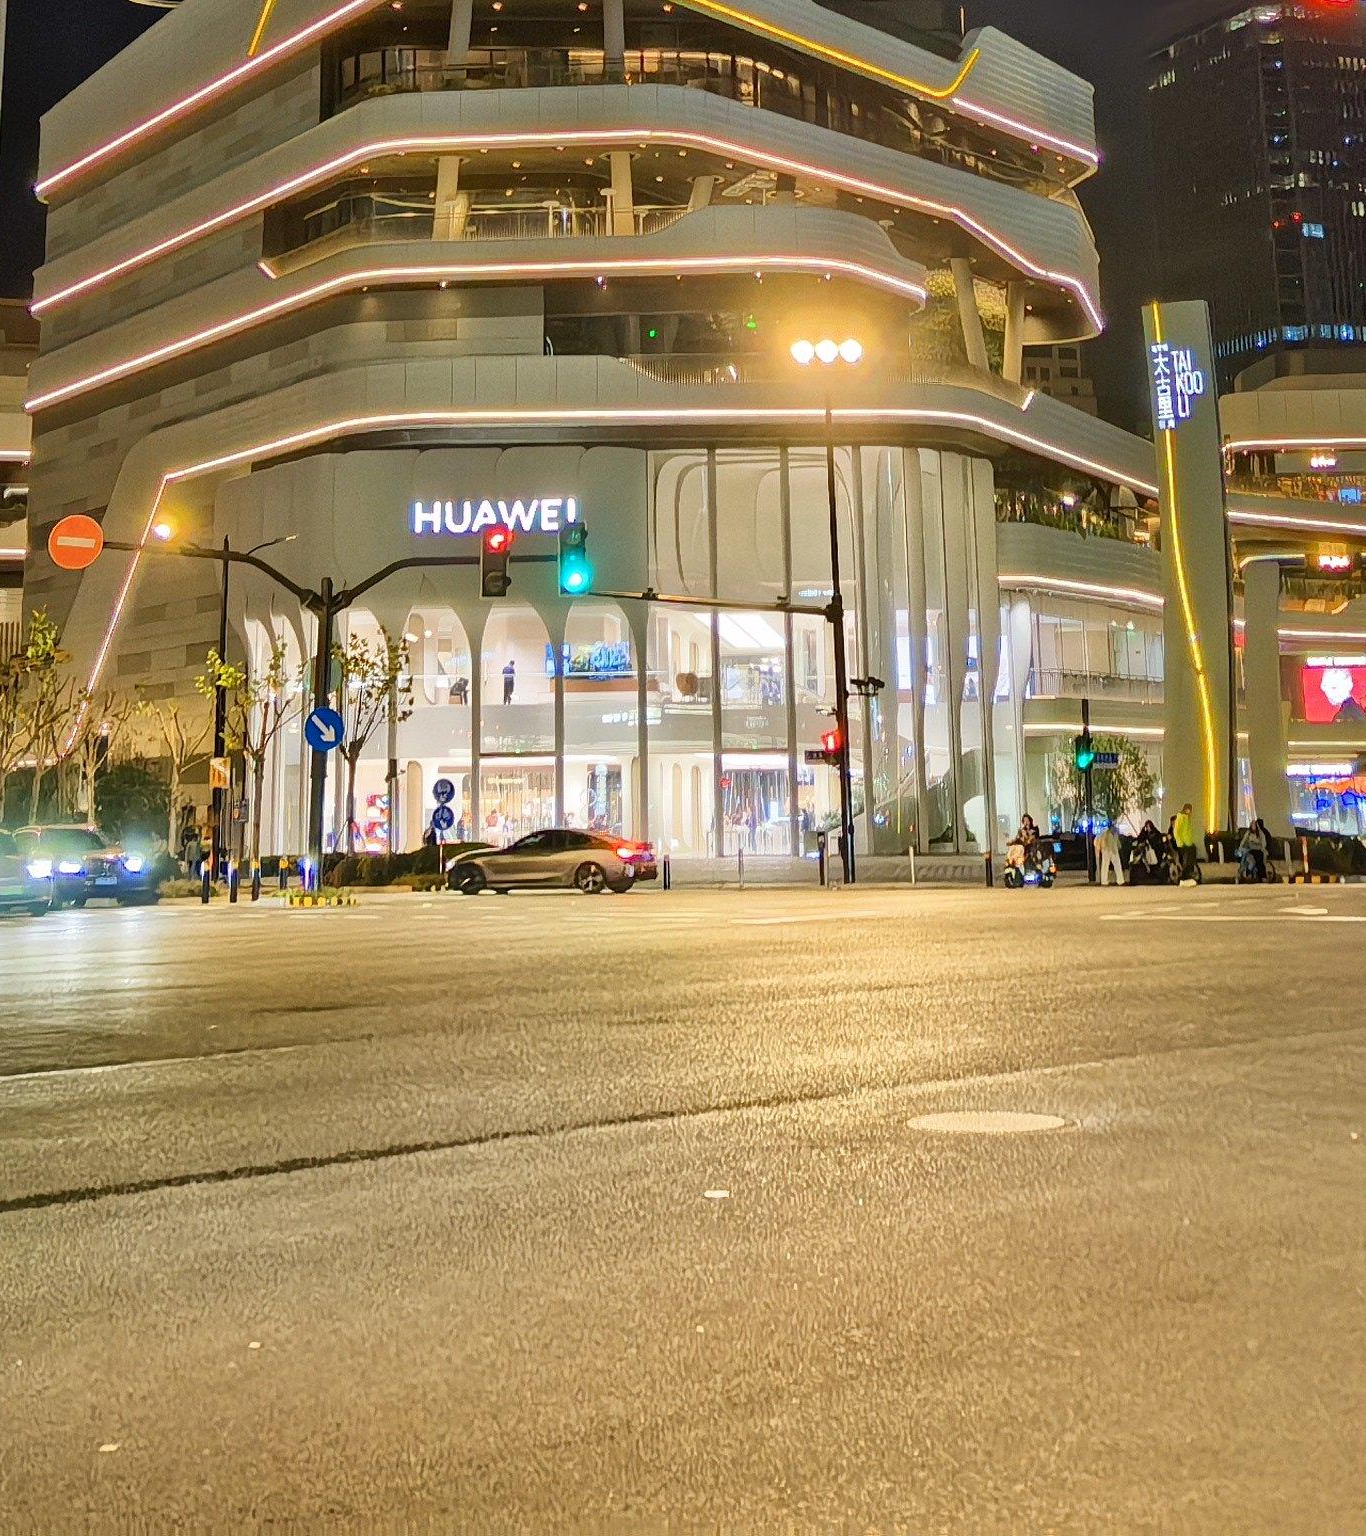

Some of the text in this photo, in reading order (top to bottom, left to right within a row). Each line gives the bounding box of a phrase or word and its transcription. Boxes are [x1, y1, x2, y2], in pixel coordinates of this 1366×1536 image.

[1171, 350, 1192, 373] TAI
[1152, 351, 1175, 419] 太古里
[1175, 370, 1203, 396] KOO
[413, 497, 576, 534] HUAWEI
